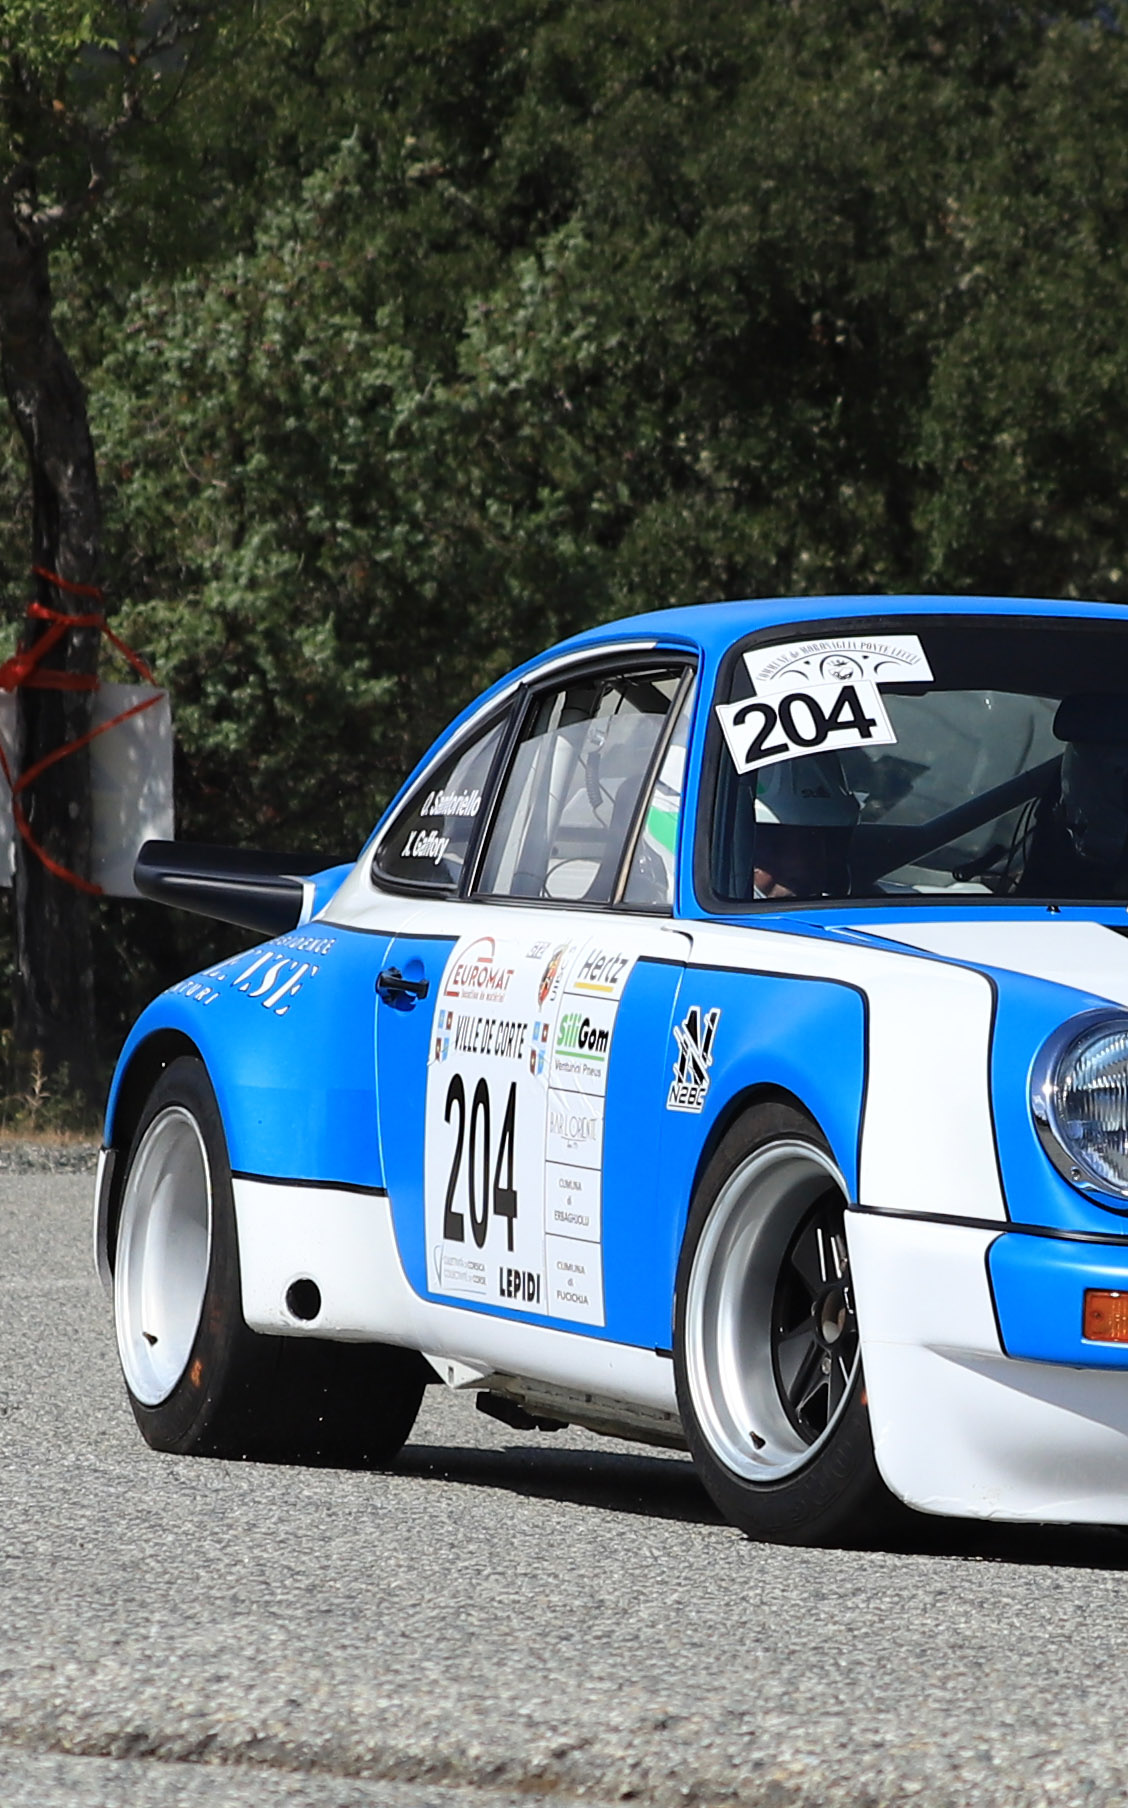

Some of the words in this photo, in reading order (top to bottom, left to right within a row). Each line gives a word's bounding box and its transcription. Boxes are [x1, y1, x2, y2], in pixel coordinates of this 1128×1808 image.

[732, 685, 878, 764] 204
[452, 963, 514, 992] EUROMAT
[577, 950, 629, 983] Hertz
[454, 1015, 483, 1053] VILLE
[481, 1020, 496, 1055] DE
[495, 1021, 528, 1060] CORTE
[443, 1073, 518, 1253] 204
[499, 1266, 541, 1304] LEPIDI
